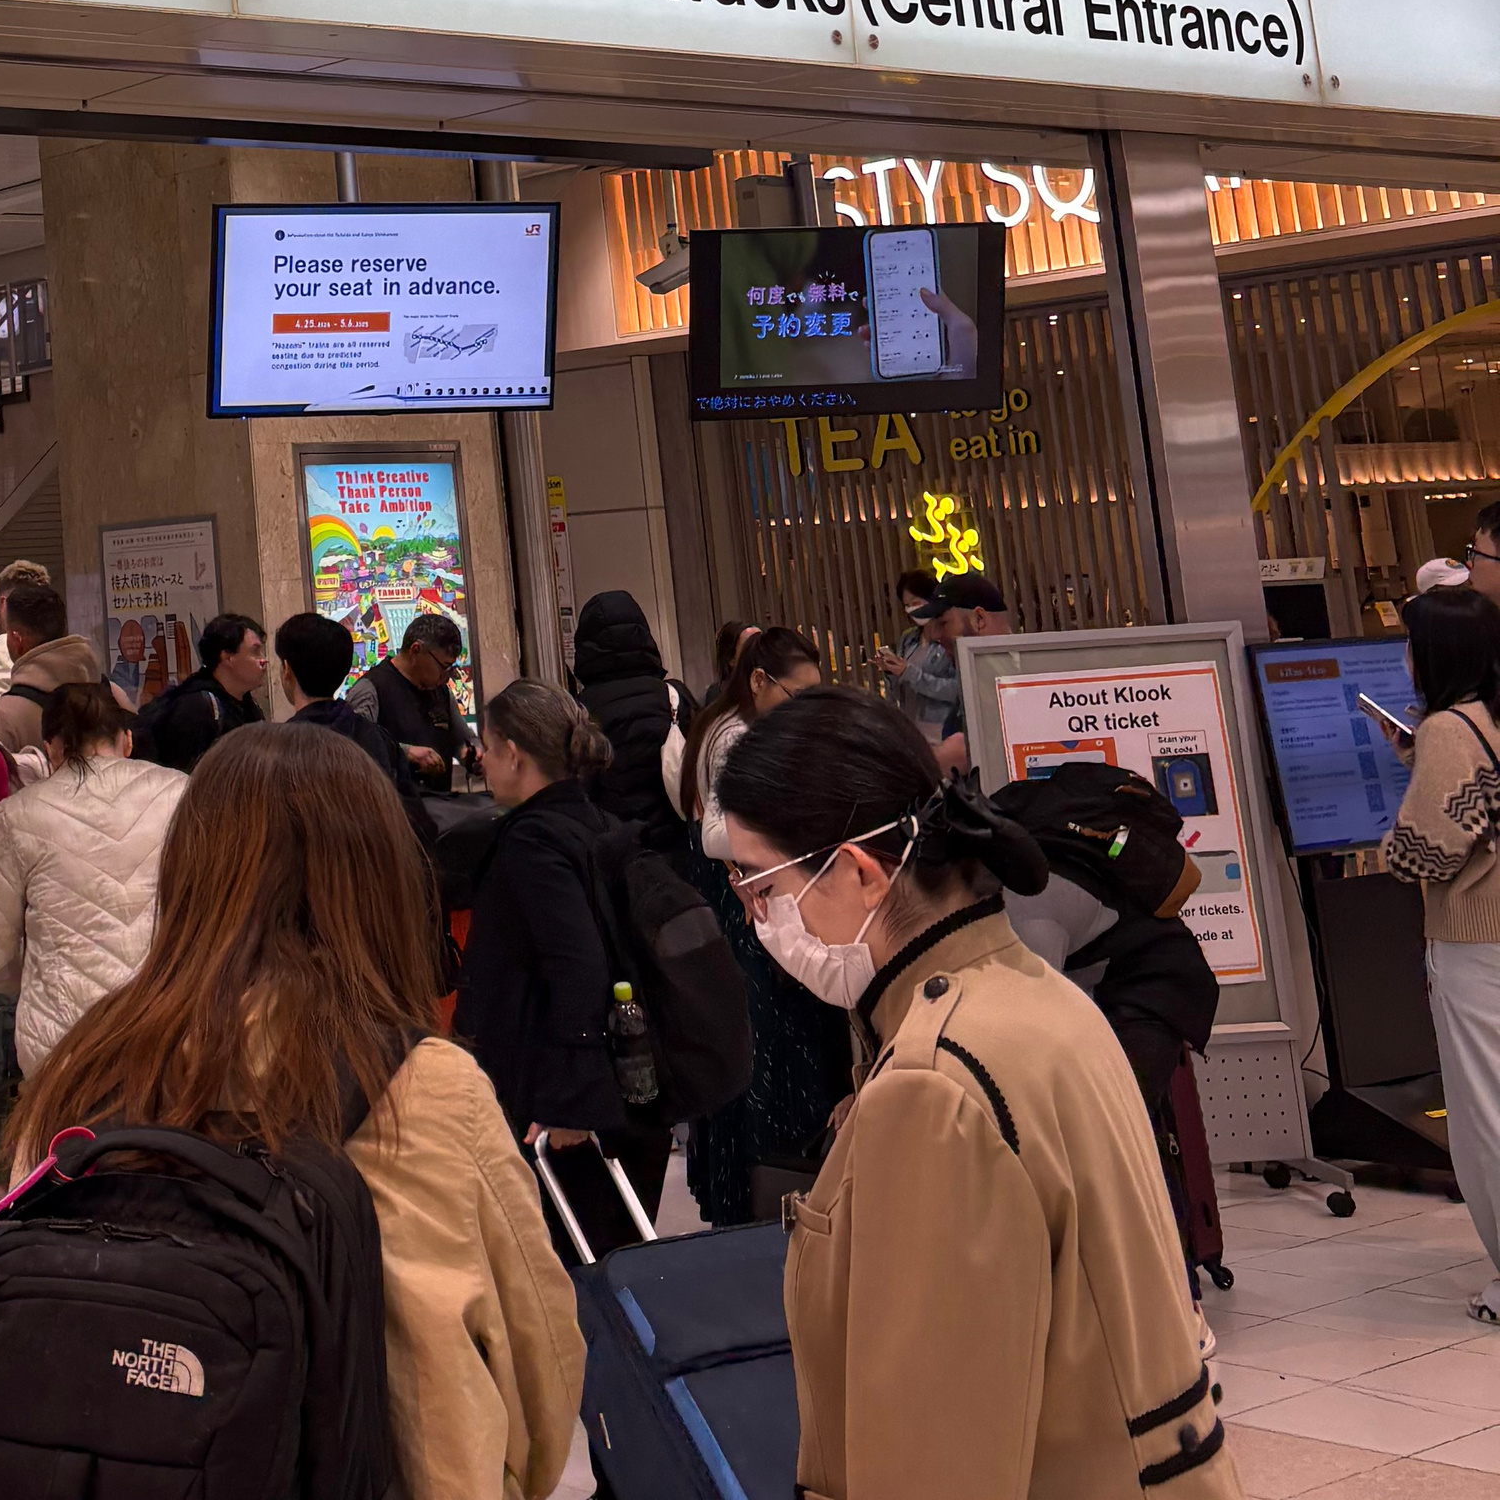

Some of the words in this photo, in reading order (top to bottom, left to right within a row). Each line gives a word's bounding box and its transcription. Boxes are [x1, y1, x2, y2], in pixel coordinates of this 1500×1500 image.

[274, 255, 343, 274] Please
[351, 257, 428, 273] reserve
[274, 282, 321, 300] your
[328, 279, 372, 296] seat
[383, 278, 400, 296] in
[408, 276, 501, 295] advance.
[747, 282, 859, 307] 何度でも無料で
[752, 311, 853, 340] 予約変更
[770, 413, 922, 477] TEA
[951, 426, 1002, 461] eat
[1008, 424, 1038, 455] in
[335, 470, 375, 485] Think
[376, 469, 430, 484] Creative
[337, 485, 376, 499] Thank
[378, 485, 422, 499] Person
[339, 500, 371, 514] Take
[379, 498, 432, 513] Ambition
[377, 588, 412, 597] TAMURA
[1049, 689, 1108, 709] About
[1114, 684, 1172, 704] Klook
[1067, 715, 1099, 733] QR
[1104, 711, 1160, 730] ticket
[1199, 904, 1244, 916] tickets.
[1221, 929, 1234, 940] at
[142, 1338, 177, 1360] THE
[112, 1349, 174, 1376] NORTH
[126, 1368, 172, 1391] FACE
